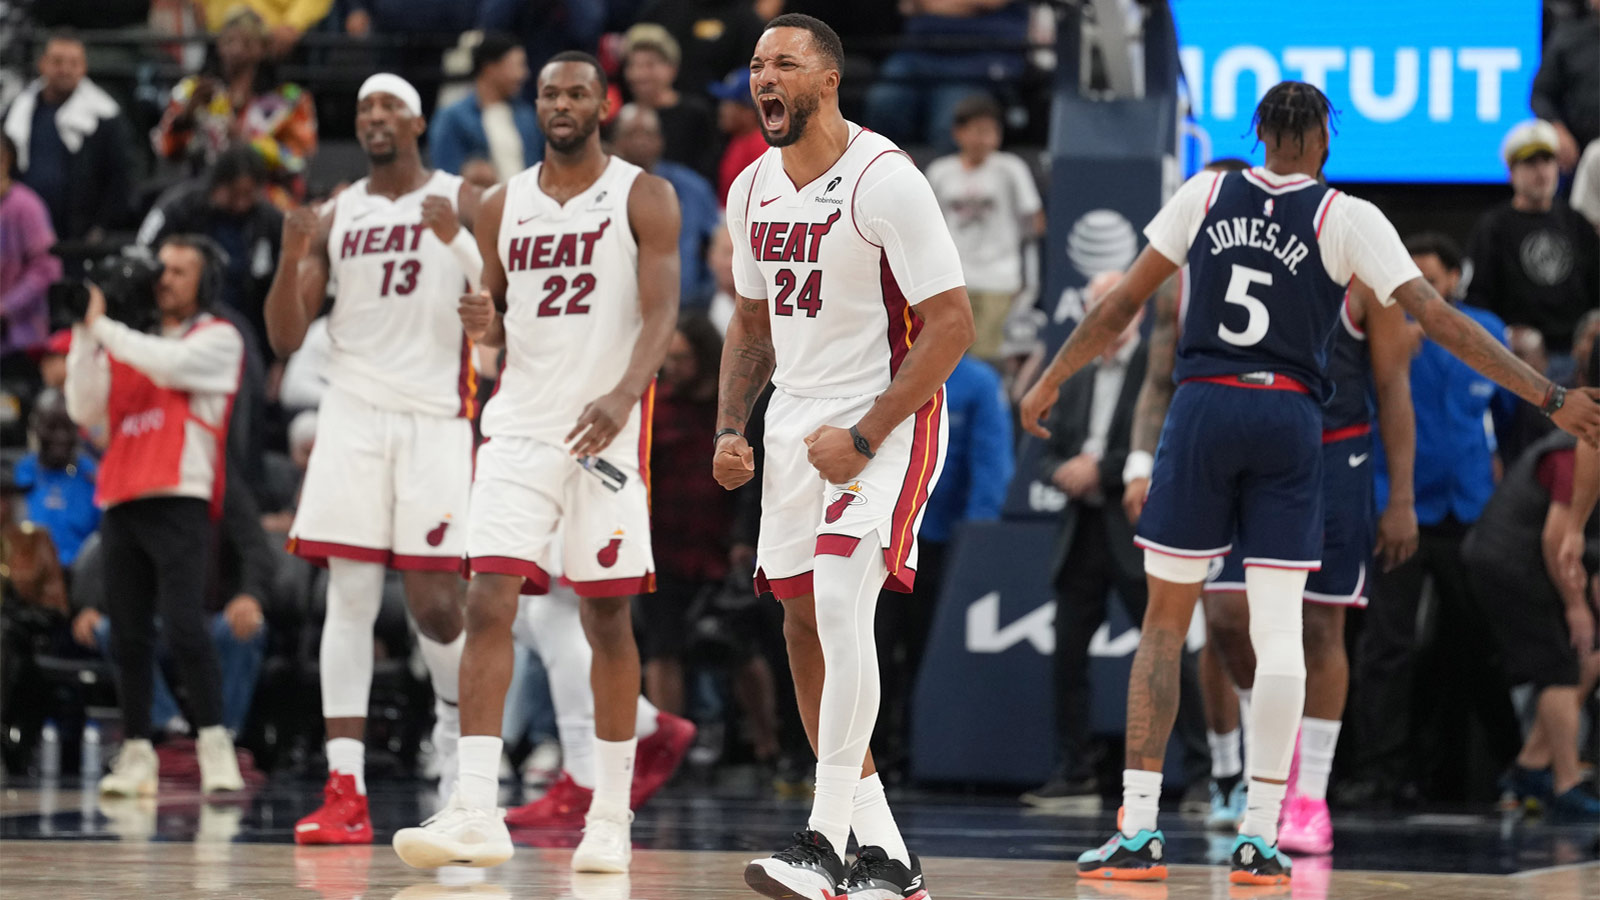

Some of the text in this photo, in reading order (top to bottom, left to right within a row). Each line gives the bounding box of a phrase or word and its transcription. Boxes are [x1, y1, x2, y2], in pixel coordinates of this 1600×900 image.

[815, 196, 844, 205] Robinhood
[508, 216, 611, 272] HEAT
[750, 207, 842, 263] HEAT
[380, 259, 422, 297] 13
[536, 272, 597, 318] 22
[775, 268, 823, 318] 24
[1217, 263, 1273, 347] 5
